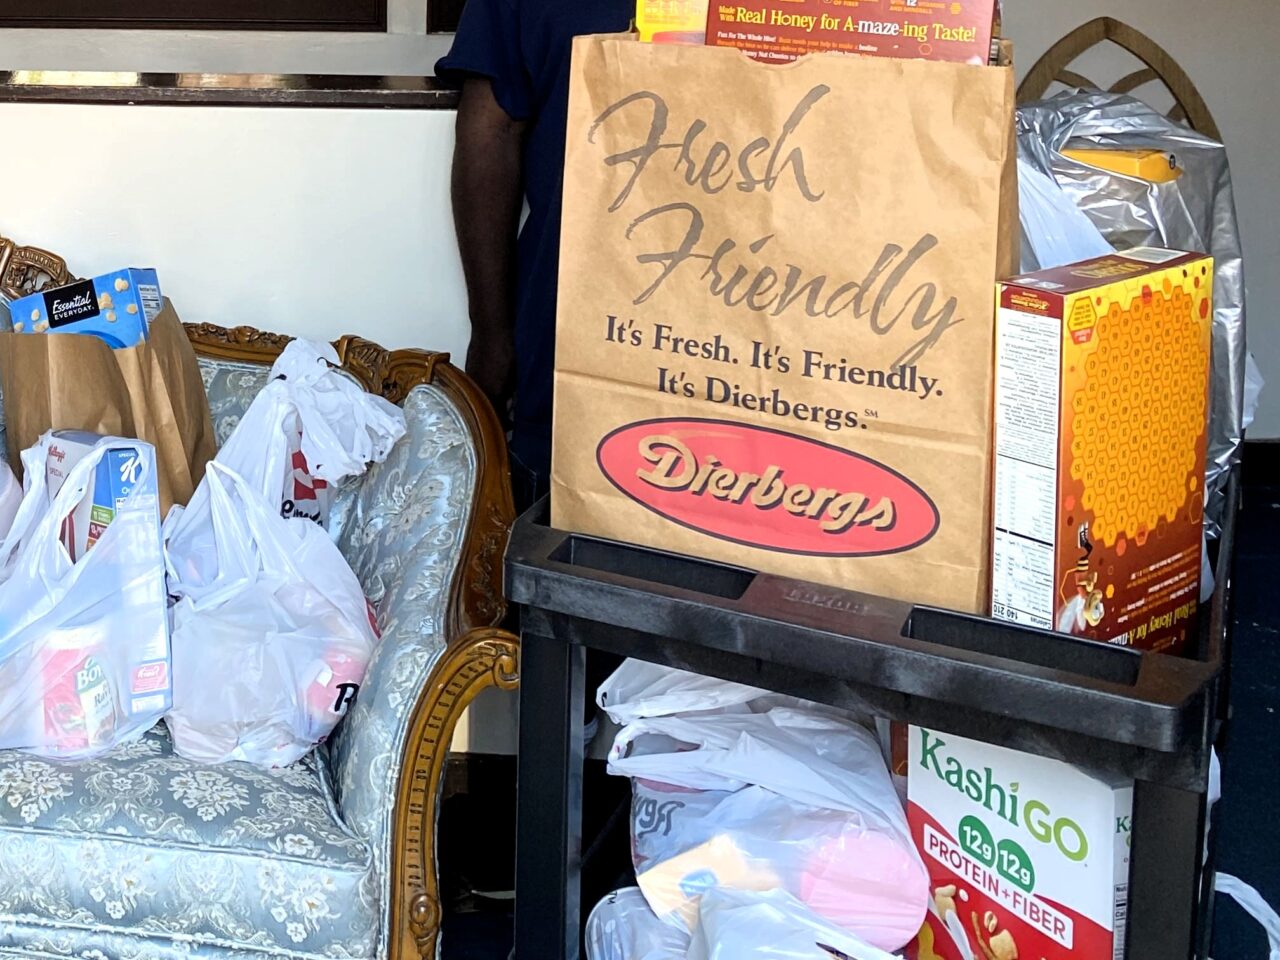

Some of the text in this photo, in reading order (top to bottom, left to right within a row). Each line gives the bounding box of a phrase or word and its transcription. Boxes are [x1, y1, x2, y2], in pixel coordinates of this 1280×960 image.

[736, 7, 766, 24] Real
[770, 10, 817, 32] Honey
[820, 13, 840, 31] for
[933, 23, 976, 42] Taste!
[587, 83, 831, 213] Fresh
[52, 290, 92, 314] Essential
[625, 202, 965, 373] Friendly
[54, 305, 92, 321] EVERYDAY
[605, 314, 945, 400] It's Fresh. It's Friendly.
[657, 367, 696, 401] It's
[705, 375, 869, 431] Dierbergs.
[120, 457, 141, 483] K
[635, 434, 898, 534] Dierbergs
[920, 727, 1089, 862] Kashi GO
[963, 825, 992, 858] 12g
[999, 849, 1031, 886] 12g
